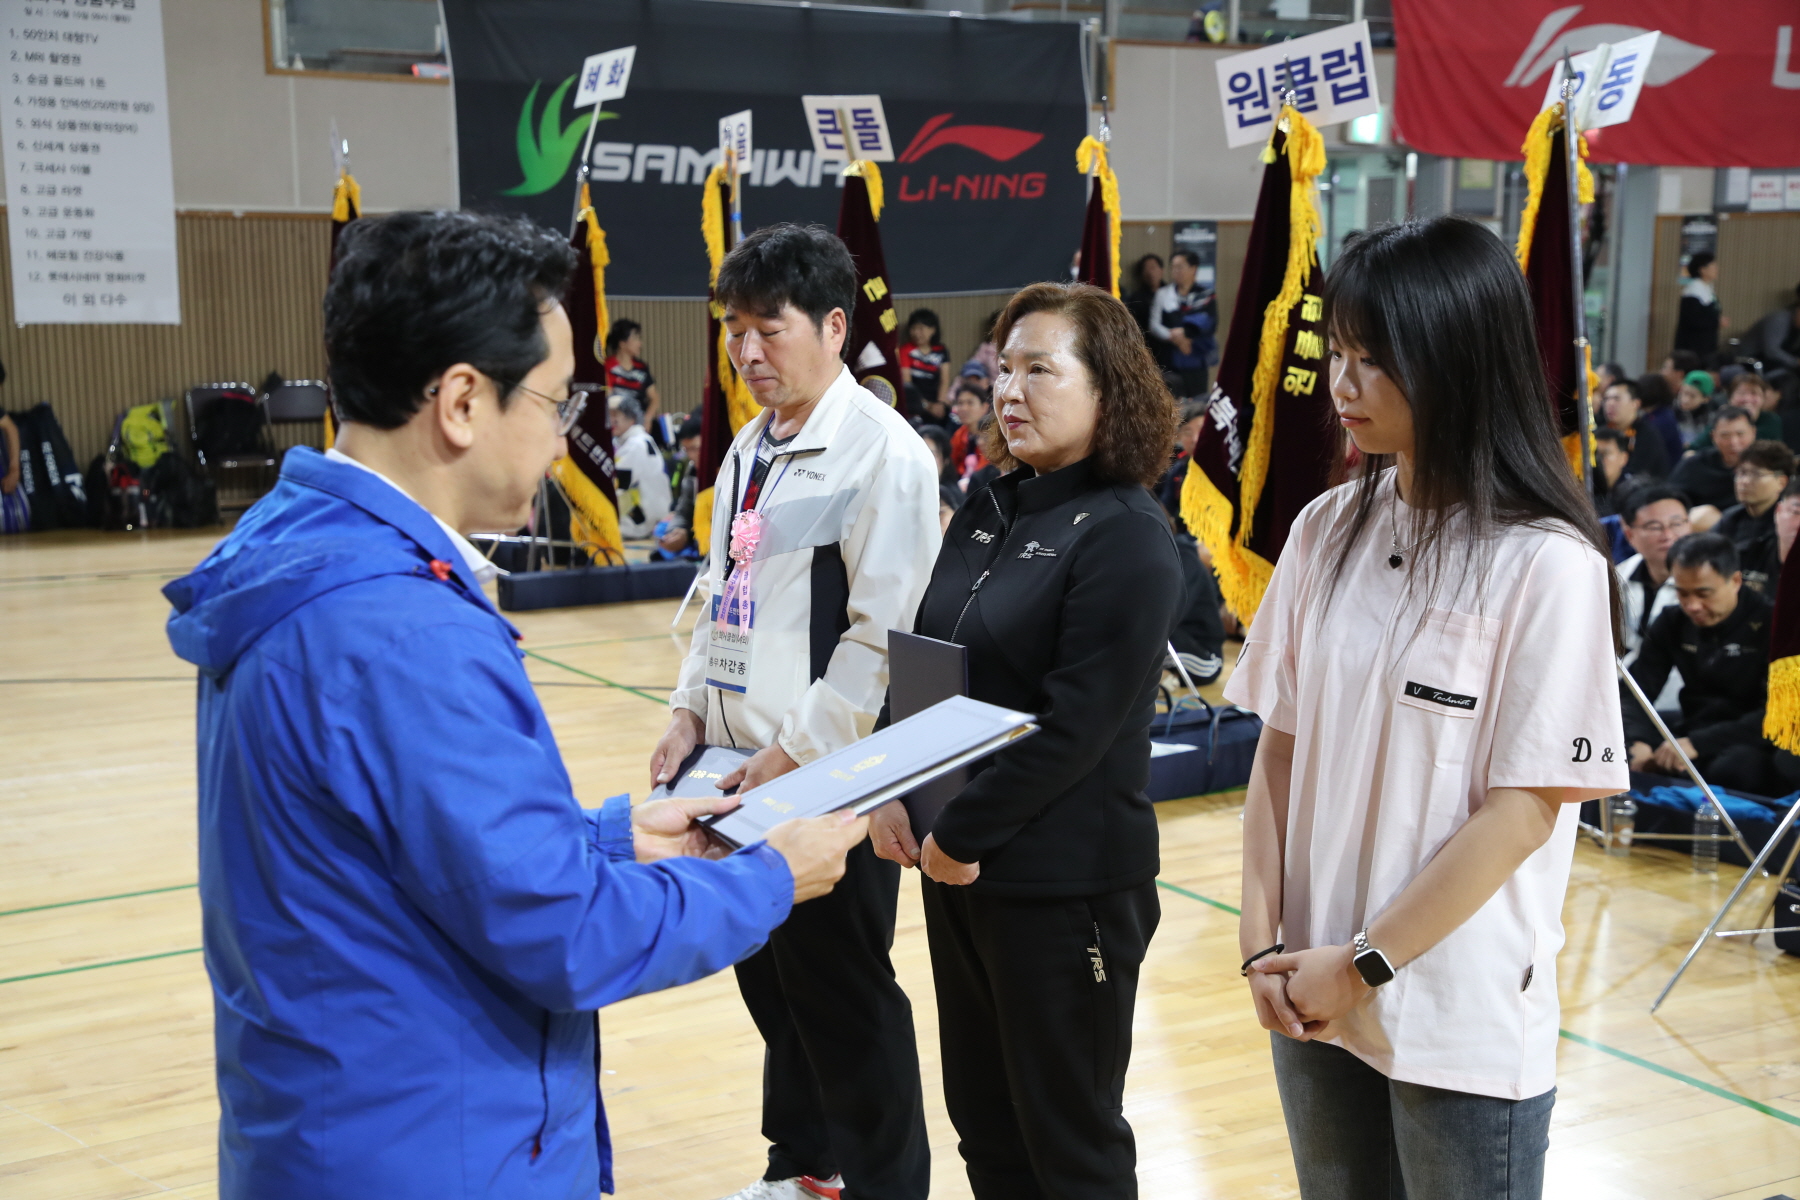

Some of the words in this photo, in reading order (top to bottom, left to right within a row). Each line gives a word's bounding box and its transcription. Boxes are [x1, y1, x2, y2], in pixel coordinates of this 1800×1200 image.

[1228, 42, 1370, 128] 원클럽
[816, 108, 882, 151] 콘돌
[898, 172, 1047, 201] LI-NING
[806, 470, 826, 482] YONEX
[970, 529, 994, 544] TRS
[719, 658, 746, 675] 차갑종
[1572, 737, 1592, 762] D
[1602, 748, 1614, 762] &
[1086, 944, 1106, 983] TRS
